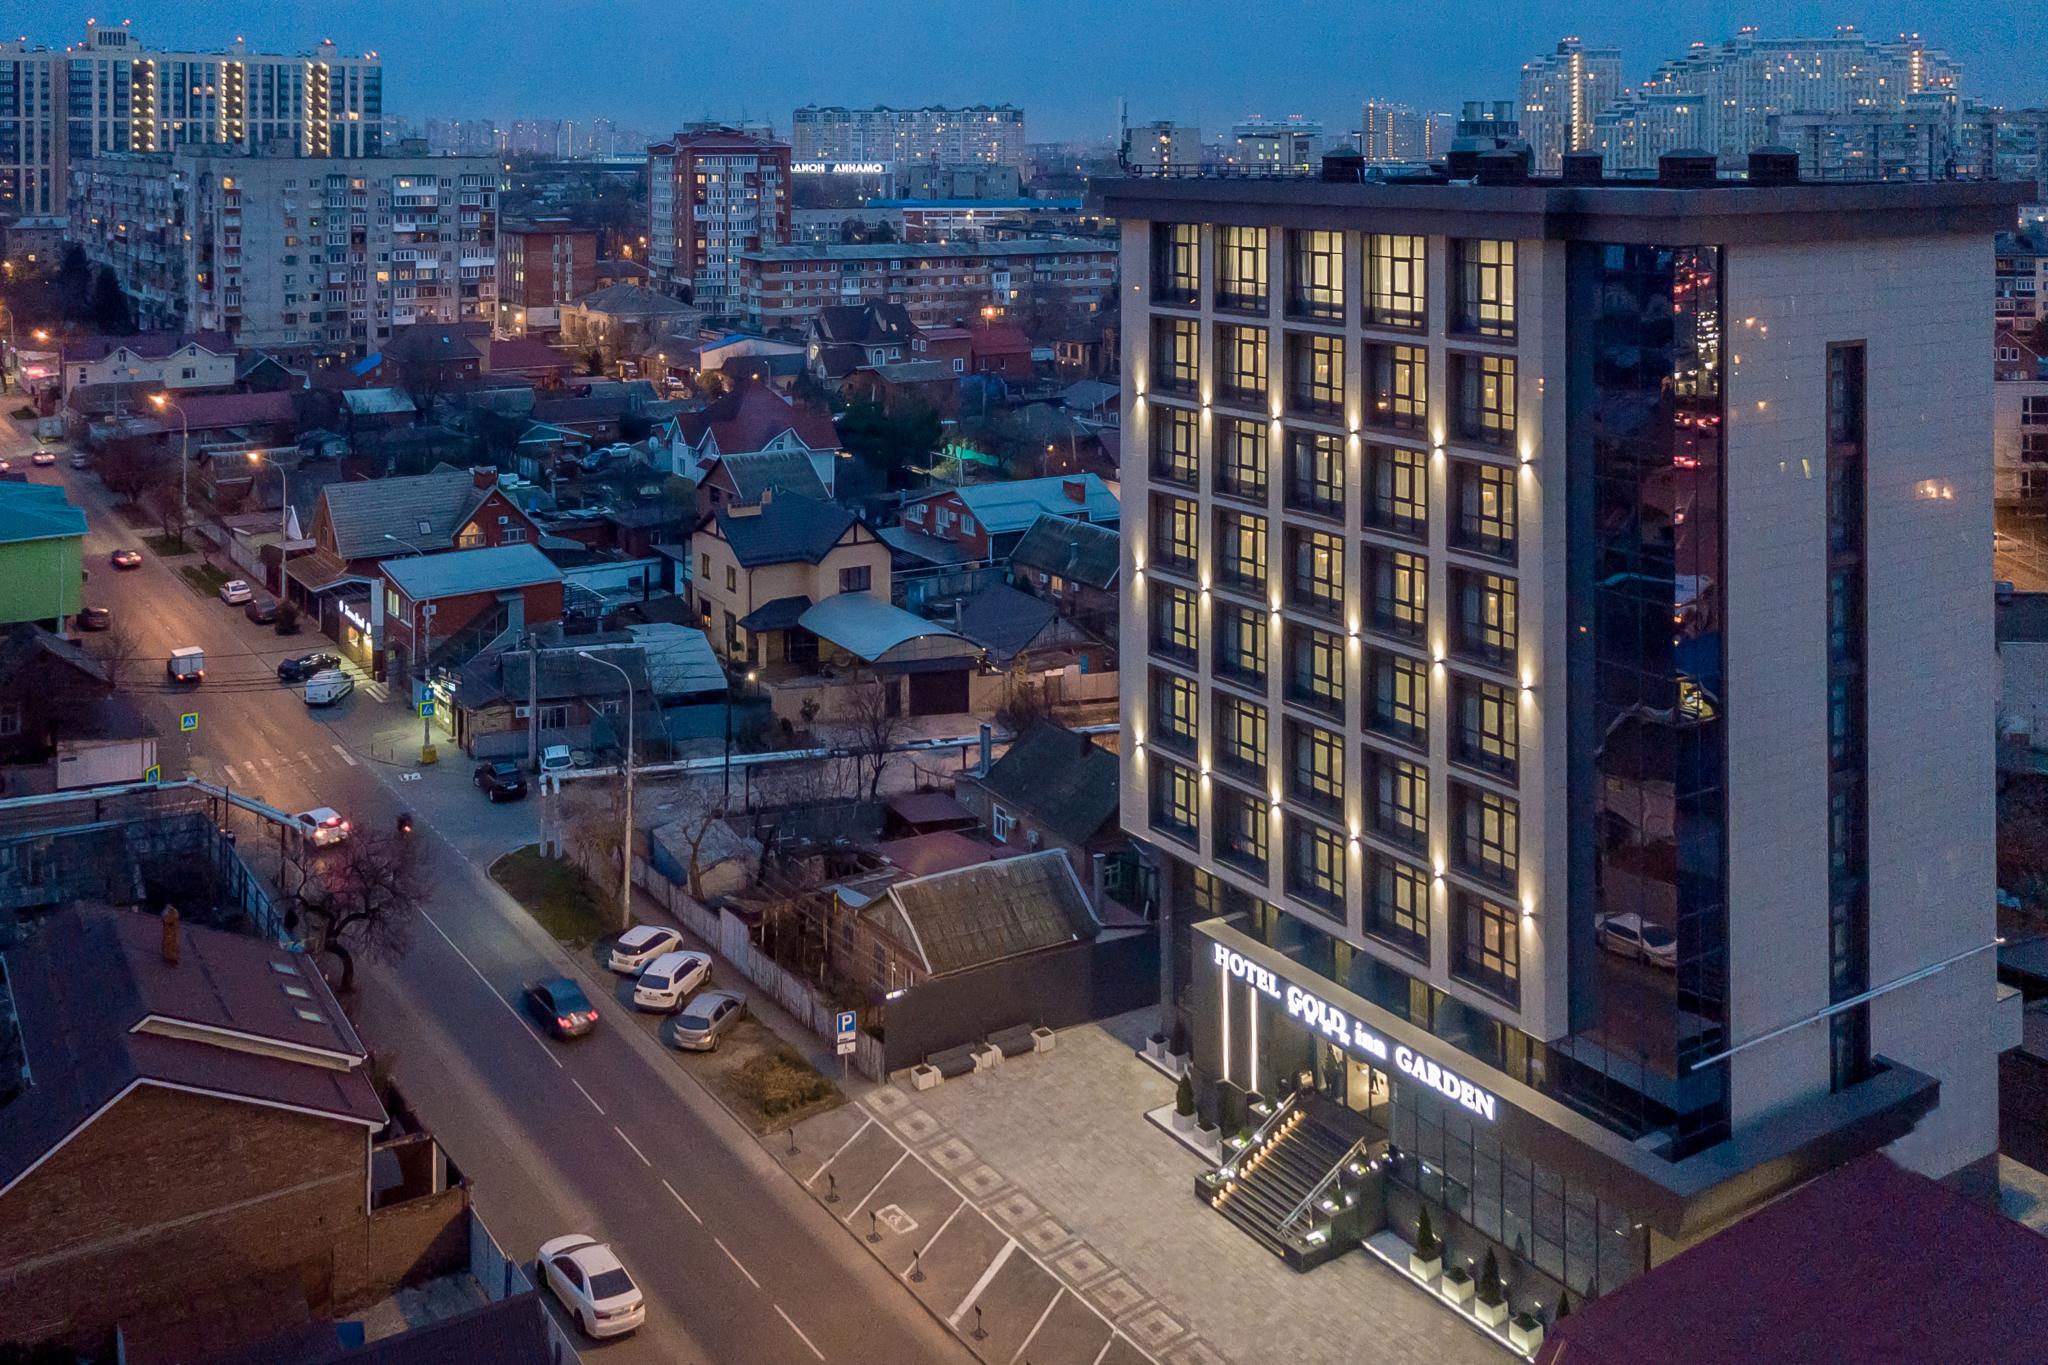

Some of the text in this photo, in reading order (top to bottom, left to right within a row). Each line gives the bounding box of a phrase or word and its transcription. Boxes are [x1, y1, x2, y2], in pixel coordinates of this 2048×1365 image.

[833, 163, 883, 173] ДИНАМО
[841, 1014, 853, 1032] P
[1214, 943, 1496, 1121] HOTEL GOLD inn GARDEN
